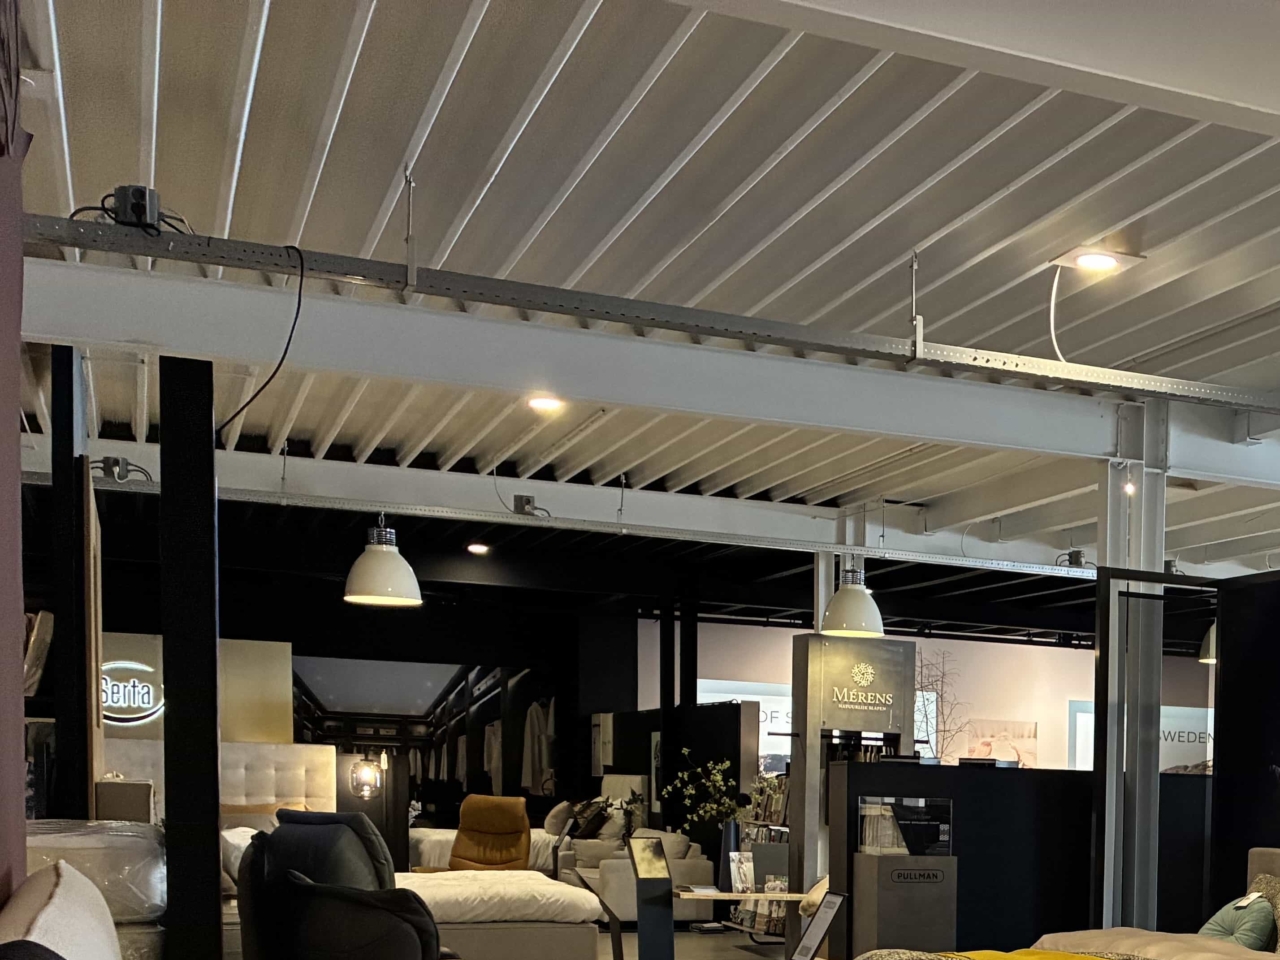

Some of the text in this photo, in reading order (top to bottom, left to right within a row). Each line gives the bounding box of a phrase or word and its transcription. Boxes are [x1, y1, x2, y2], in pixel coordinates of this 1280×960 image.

[832, 686, 893, 705] MÉRENS
[1159, 730, 1214, 743] WEDEN
[897, 872, 938, 880] PULLMAN
